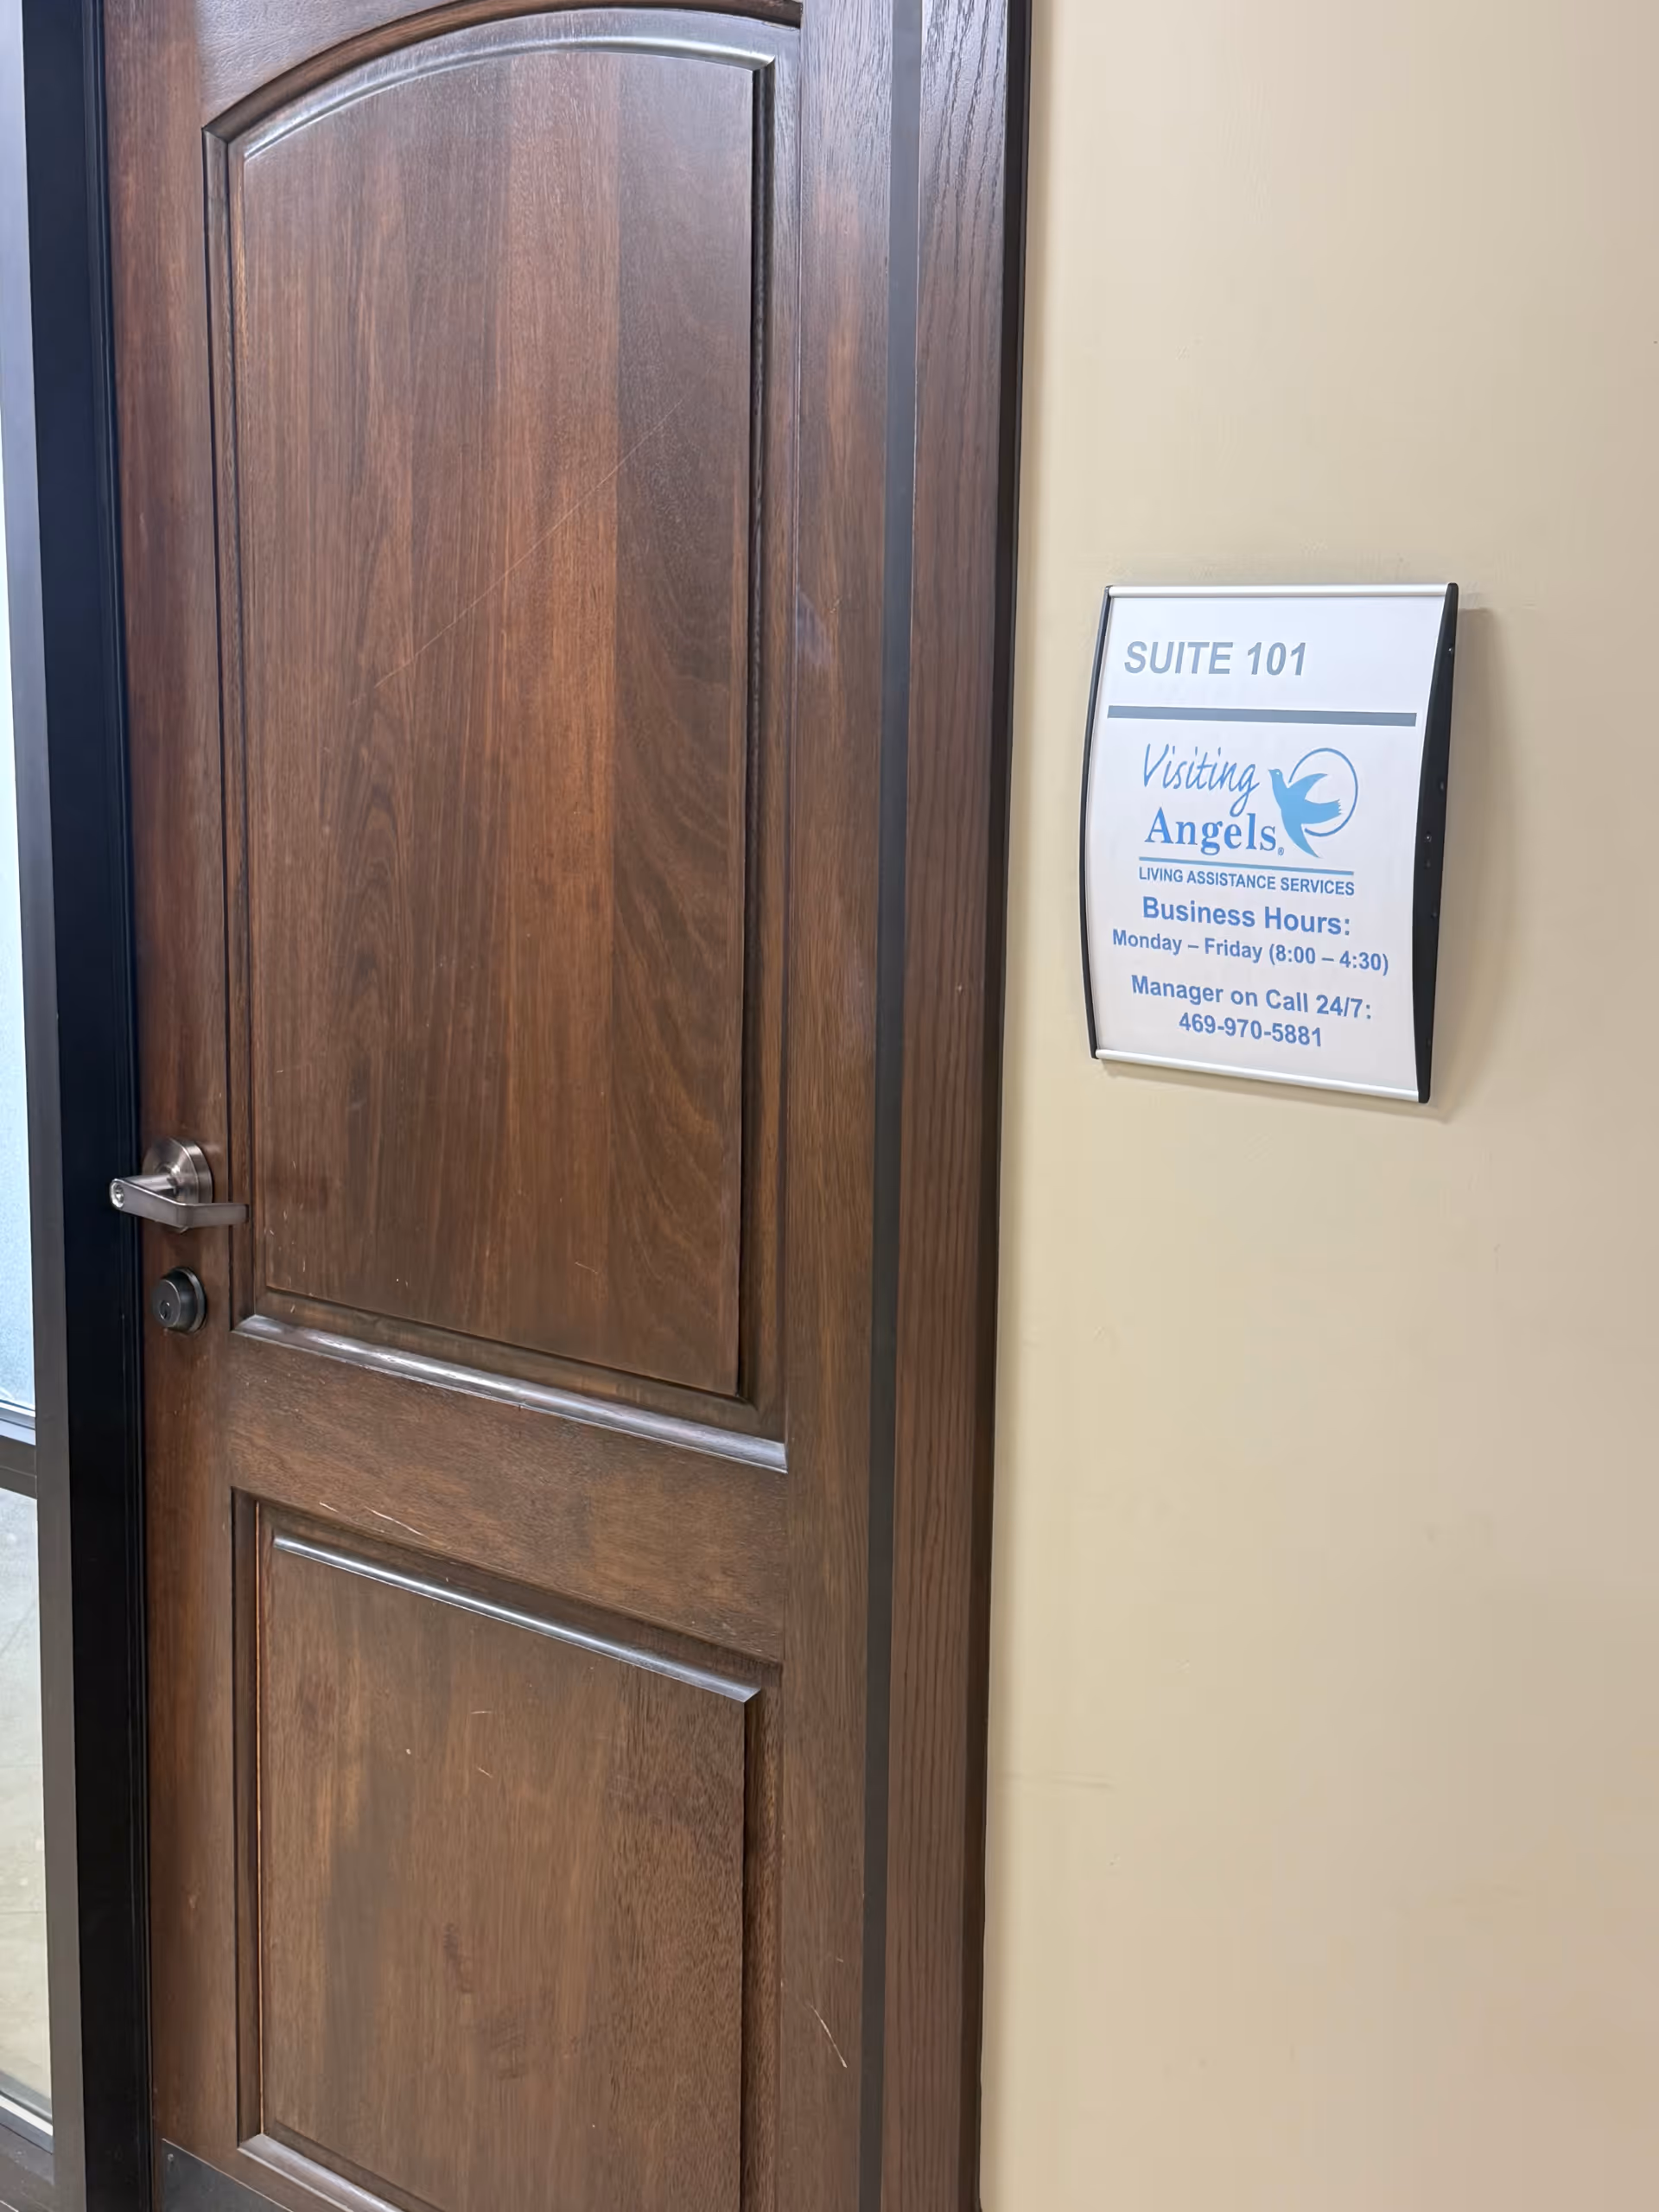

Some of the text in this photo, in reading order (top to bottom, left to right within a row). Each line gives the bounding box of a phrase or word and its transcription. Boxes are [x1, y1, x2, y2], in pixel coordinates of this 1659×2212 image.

[1123, 640, 1306, 676] SUITE 101
[1142, 743, 1260, 817] Visiting
[1139, 866, 1355, 896] LIVING ASSISTANCE SERVICES
[1142, 896, 1351, 936] Business Hours:
[1112, 928, 1182, 956] Monday
[1204, 938, 1263, 963] Friday
[1268, 944, 1316, 967] (8:00
[1339, 950, 1390, 976] 4:30)
[1131, 975, 1372, 1020] Manager on Call 24/7:
[1179, 1012, 1323, 1046] 469-970-5881
